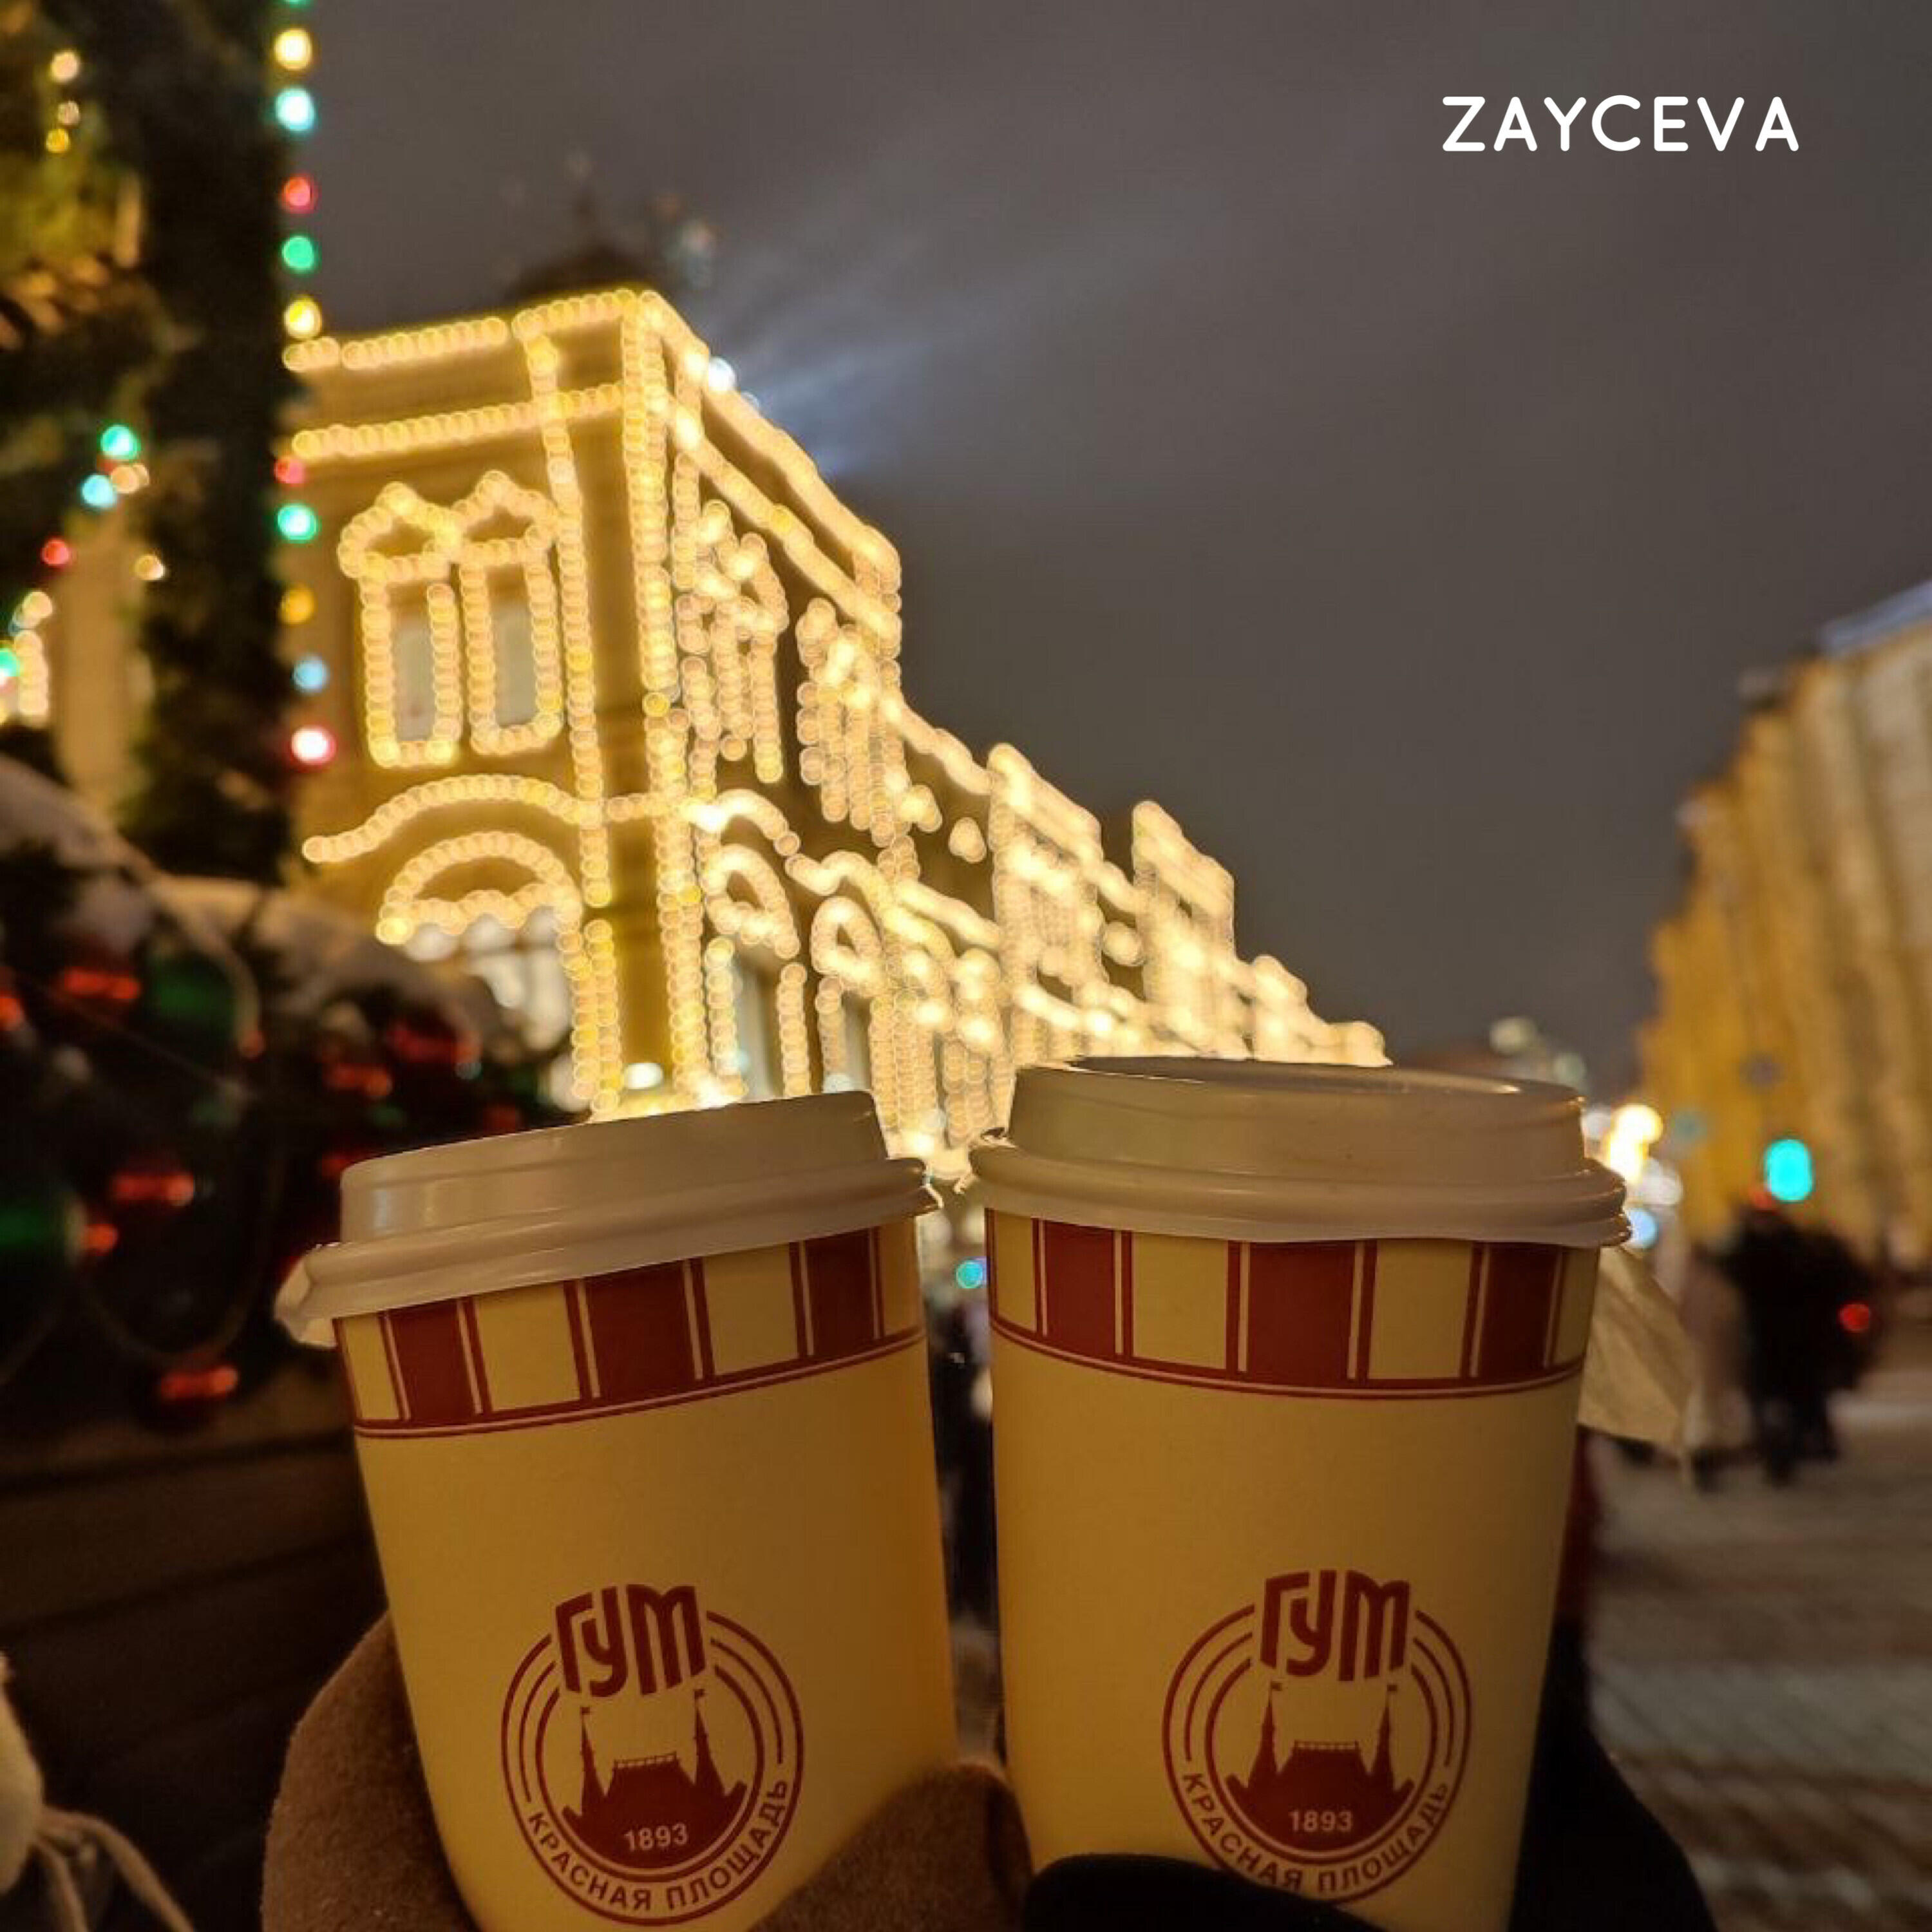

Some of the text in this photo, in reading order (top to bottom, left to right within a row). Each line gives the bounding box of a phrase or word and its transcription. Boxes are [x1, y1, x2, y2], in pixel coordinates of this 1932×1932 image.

[556, 1584, 706, 1698] ГУМ
[1260, 1569, 1410, 1681] ГУМ
[527, 1780, 788, 1910] КРАСНАЯ ПЛОЩАДЬ
[624, 1823, 688, 1852] 1893
[1183, 1773, 1449, 1892] КРАСНАЯ ПЛОЩАДЬ
[1289, 1810, 1353, 1833] 1893
